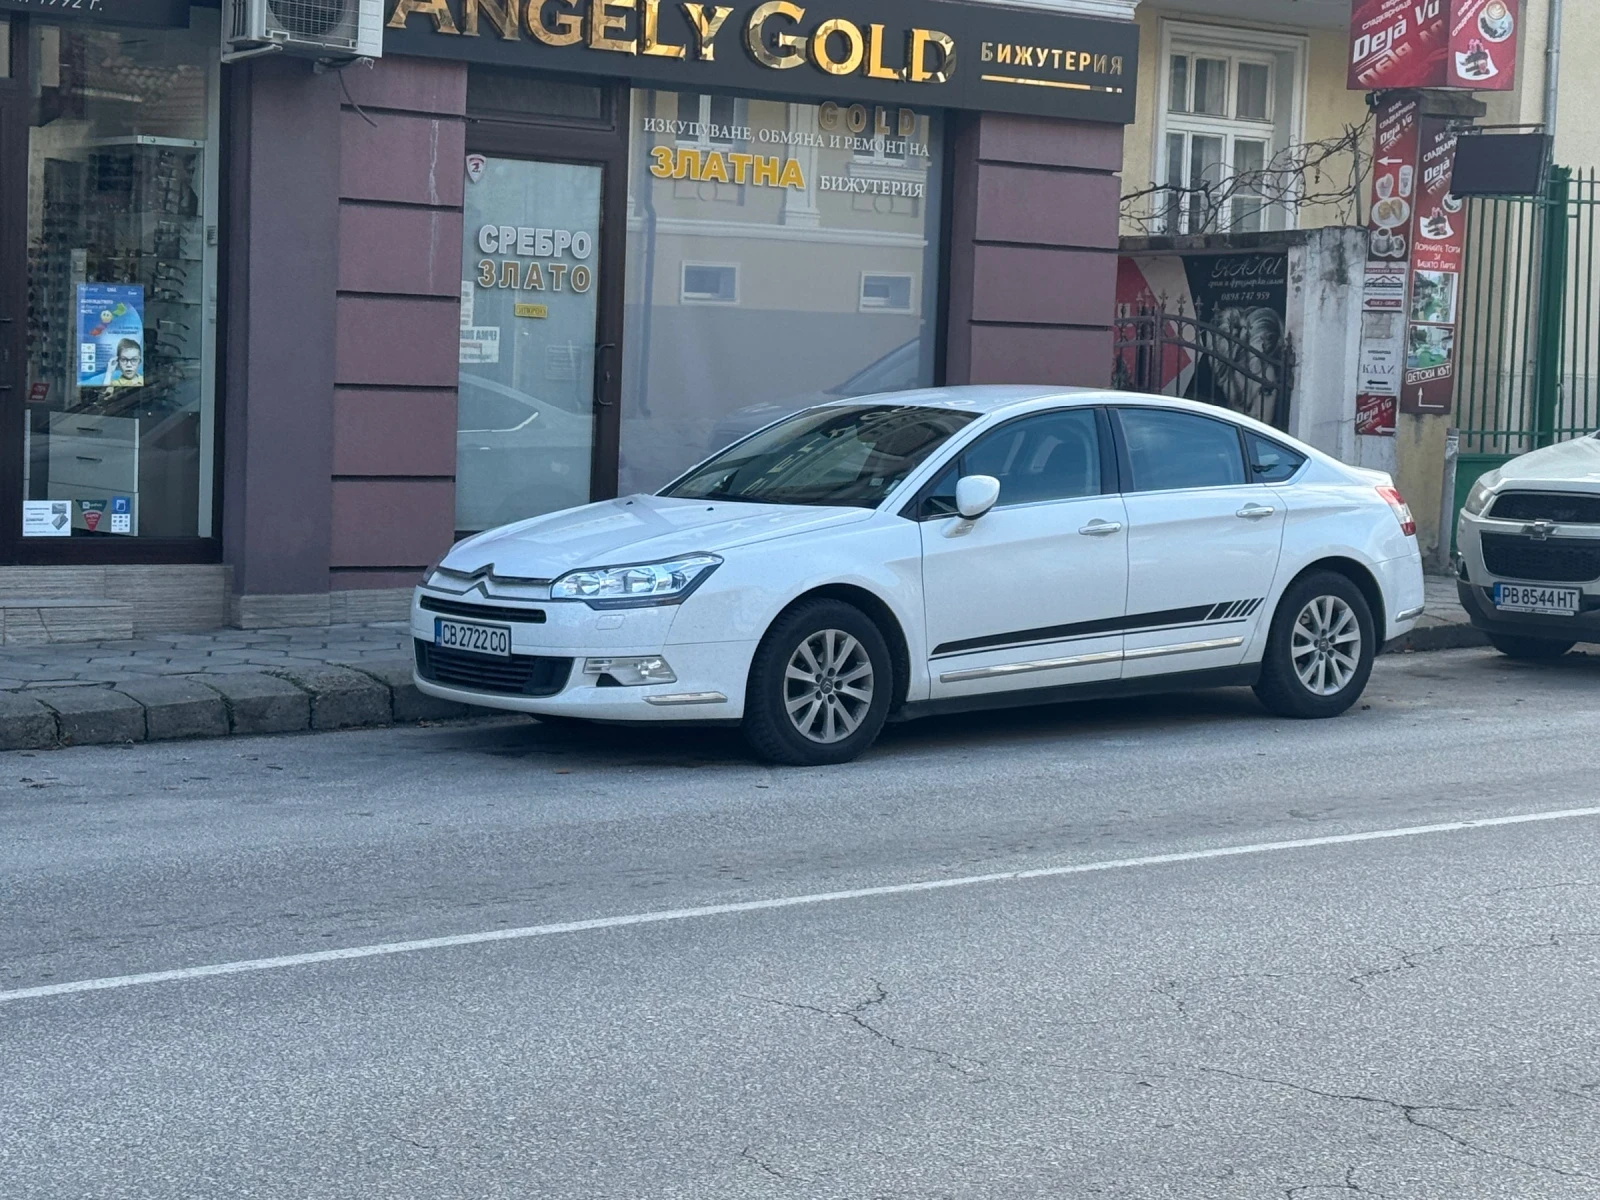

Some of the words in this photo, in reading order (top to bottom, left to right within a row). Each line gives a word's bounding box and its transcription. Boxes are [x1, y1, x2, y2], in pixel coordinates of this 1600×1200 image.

[1414, 0, 1440, 26] Vu
[747, 1, 956, 83] GOLD
[981, 42, 1123, 75] БИЖУТЕРИЯ
[819, 101, 916, 137] GOLD
[643, 118, 755, 143] ИЗКУПУВАНЕ,
[759, 128, 824, 148] ОБМЯНА
[830, 135, 841, 148] И
[843, 137, 906, 155] РЕМОНТ
[910, 143, 930, 157] НА
[650, 146, 806, 189] ЗЛАТНА
[820, 175, 925, 198] БИЖУТЕРИЯ
[478, 224, 592, 260] СРЕБРО
[478, 260, 592, 293] ЗЛАТО
[1521, 588, 1555, 607] 8544
[459, 627, 488, 651] 2722
